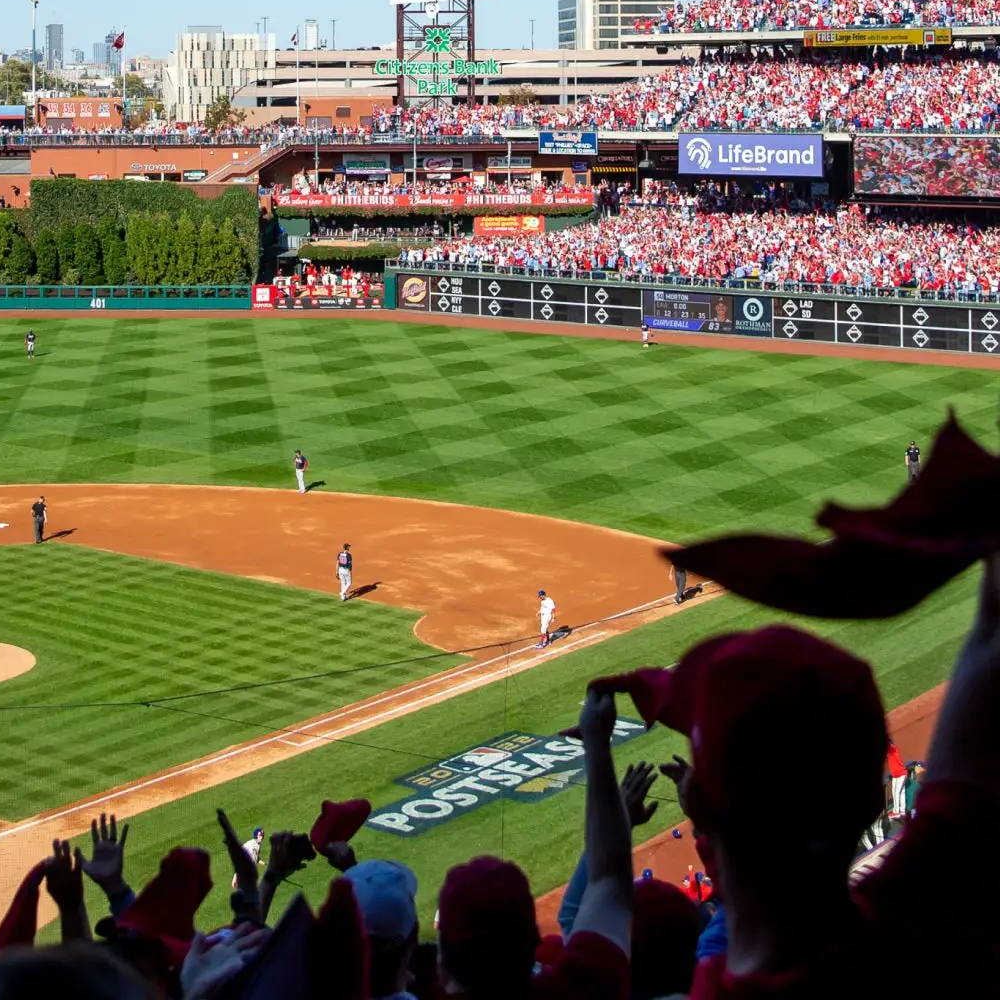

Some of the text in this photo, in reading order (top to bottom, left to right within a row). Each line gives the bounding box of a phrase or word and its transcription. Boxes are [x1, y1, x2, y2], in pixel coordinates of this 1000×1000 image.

[817, 32, 835, 42] FREE
[375, 58, 500, 75] Citizens Bank
[417, 79, 457, 95] Park
[718, 144, 814, 164] LifeBrand
[331, 195, 395, 206] #HITTHEBUDS
[466, 194, 532, 205] #HITTHEBUDS
[665, 293, 689, 301] MORTON
[90, 298, 106, 309] 401
[799, 300, 813, 308] LAD
[451, 305, 462, 313] CLE
[801, 309, 811, 318] SD
[653, 319, 689, 328] CURVEBALL
[708, 322, 720, 331] 83
[735, 320, 771, 328] ROTHMAN
[411, 734, 537, 787] 20 22
[368, 719, 645, 833] POSTSEASN
